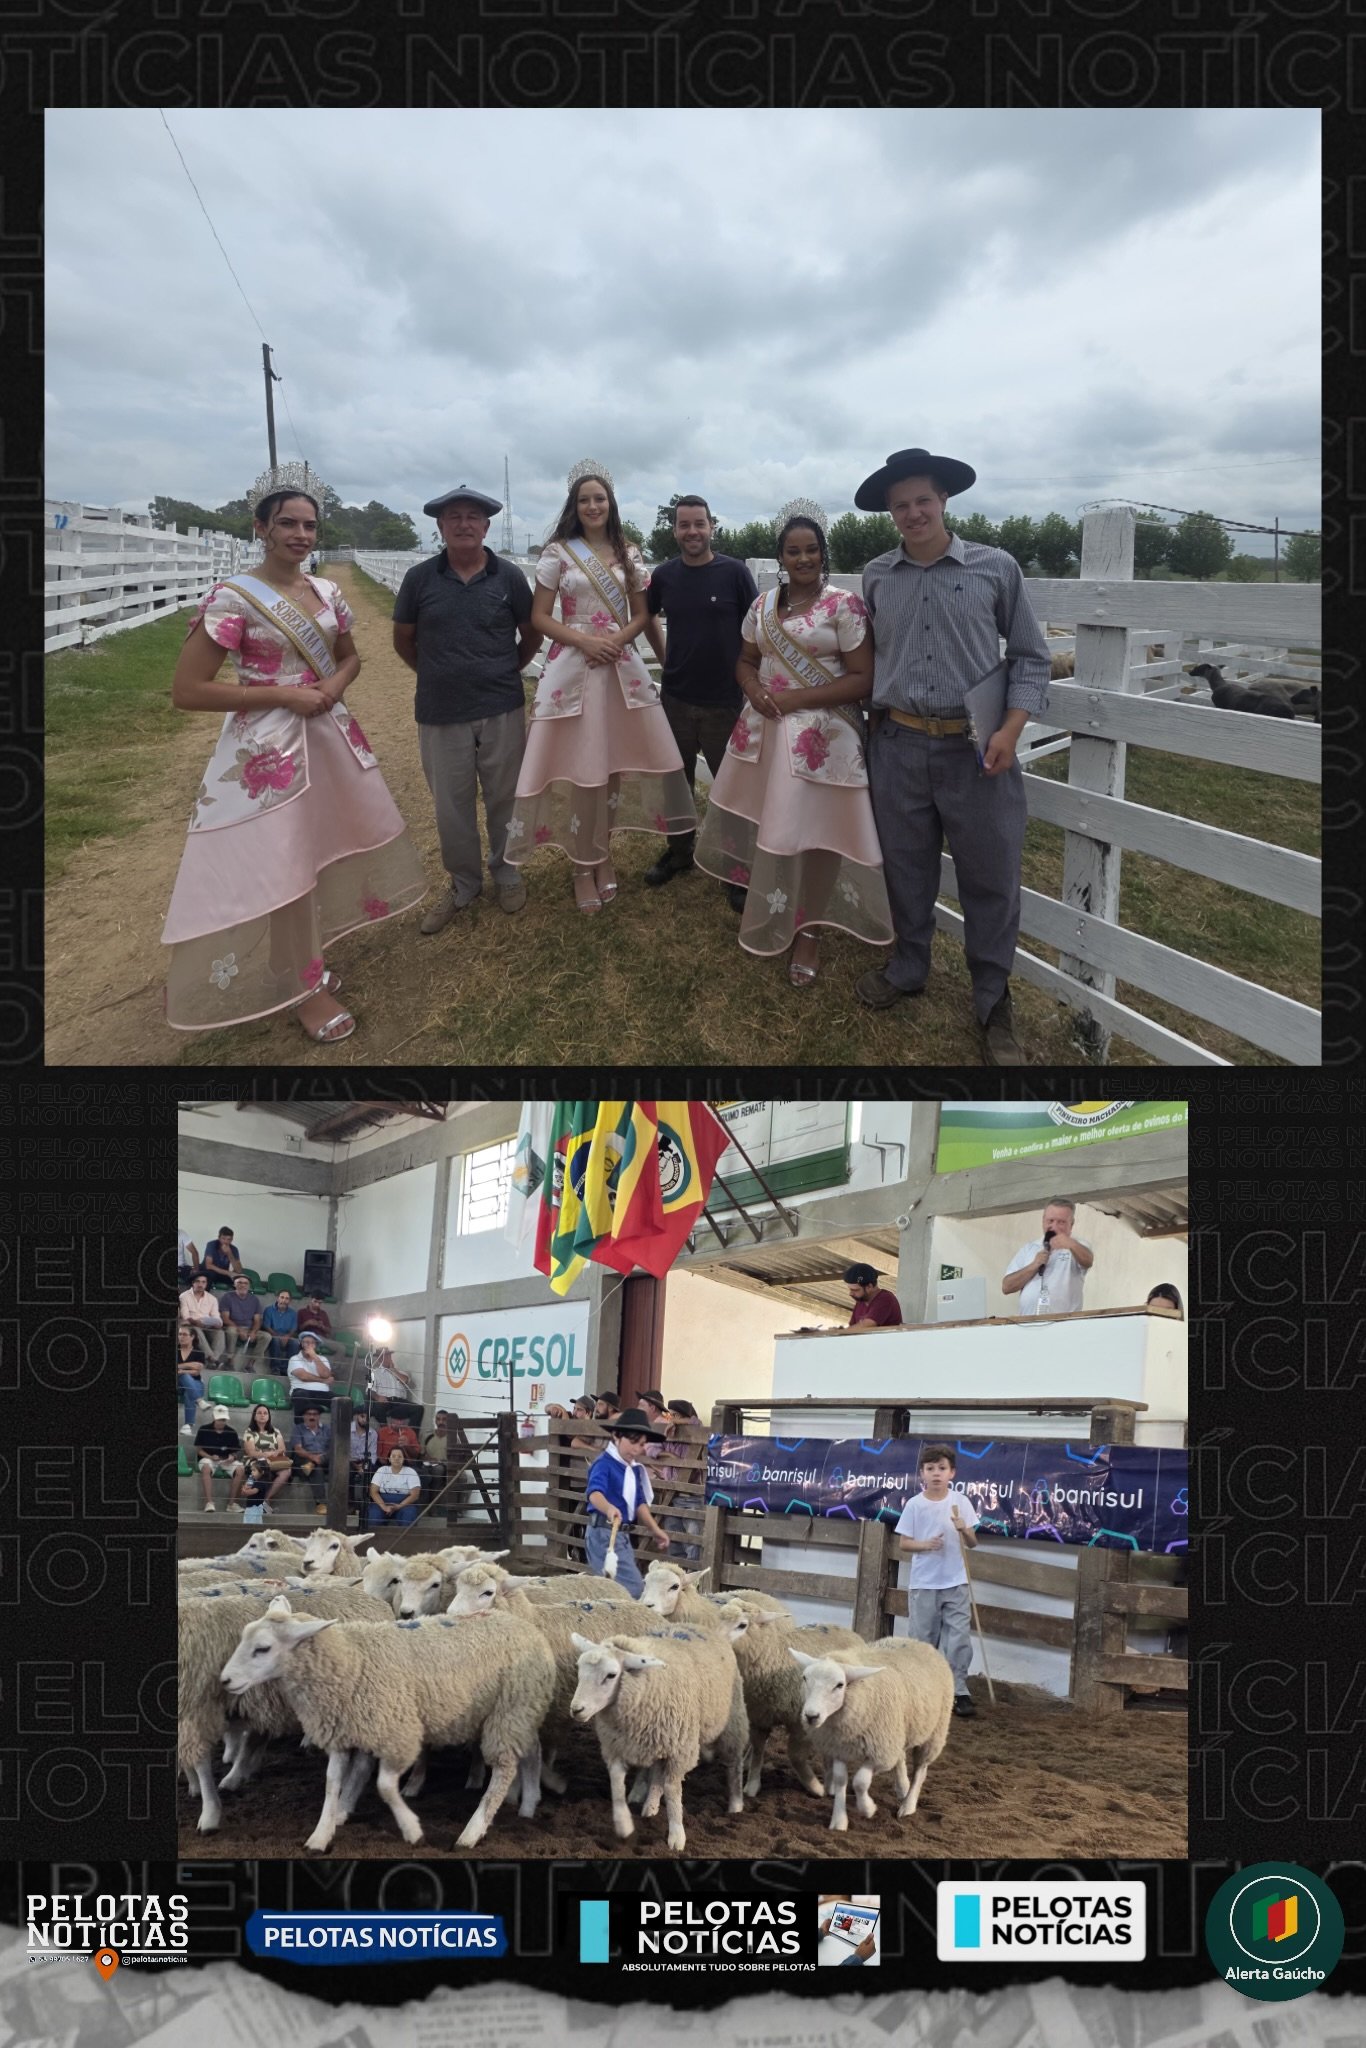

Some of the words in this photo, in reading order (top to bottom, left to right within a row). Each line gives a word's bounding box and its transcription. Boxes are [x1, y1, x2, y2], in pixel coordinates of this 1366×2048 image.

[582, 556, 616, 595] SOBERANA
[271, 600, 320, 649] SOBERANA
[314, 646, 328, 662] DA
[787, 650, 804, 668] DA
[800, 662, 828, 688] FEOV
[741, 1101, 766, 1117] REMATE
[1056, 1105, 1088, 1125] PINHEIRO
[1089, 1101, 1127, 1124] MACHADO
[992, 1147, 1012, 1160] Venha
[1020, 1142, 1044, 1154] confira
[1051, 1133, 1073, 1148] maior
[1080, 1126, 1106, 1142] melhor
[1107, 1124, 1130, 1137] oferta
[1132, 1121, 1143, 1131] de
[1144, 1115, 1170, 1129] ovinos
[1172, 1112, 1183, 1123] do
[477, 1332, 584, 1379] CRESOL
[706, 1463, 737, 1480] nrisul
[762, 1466, 817, 1485] banrisul
[847, 1471, 909, 1491] banrisul
[1054, 1483, 1143, 1510] banrisul
